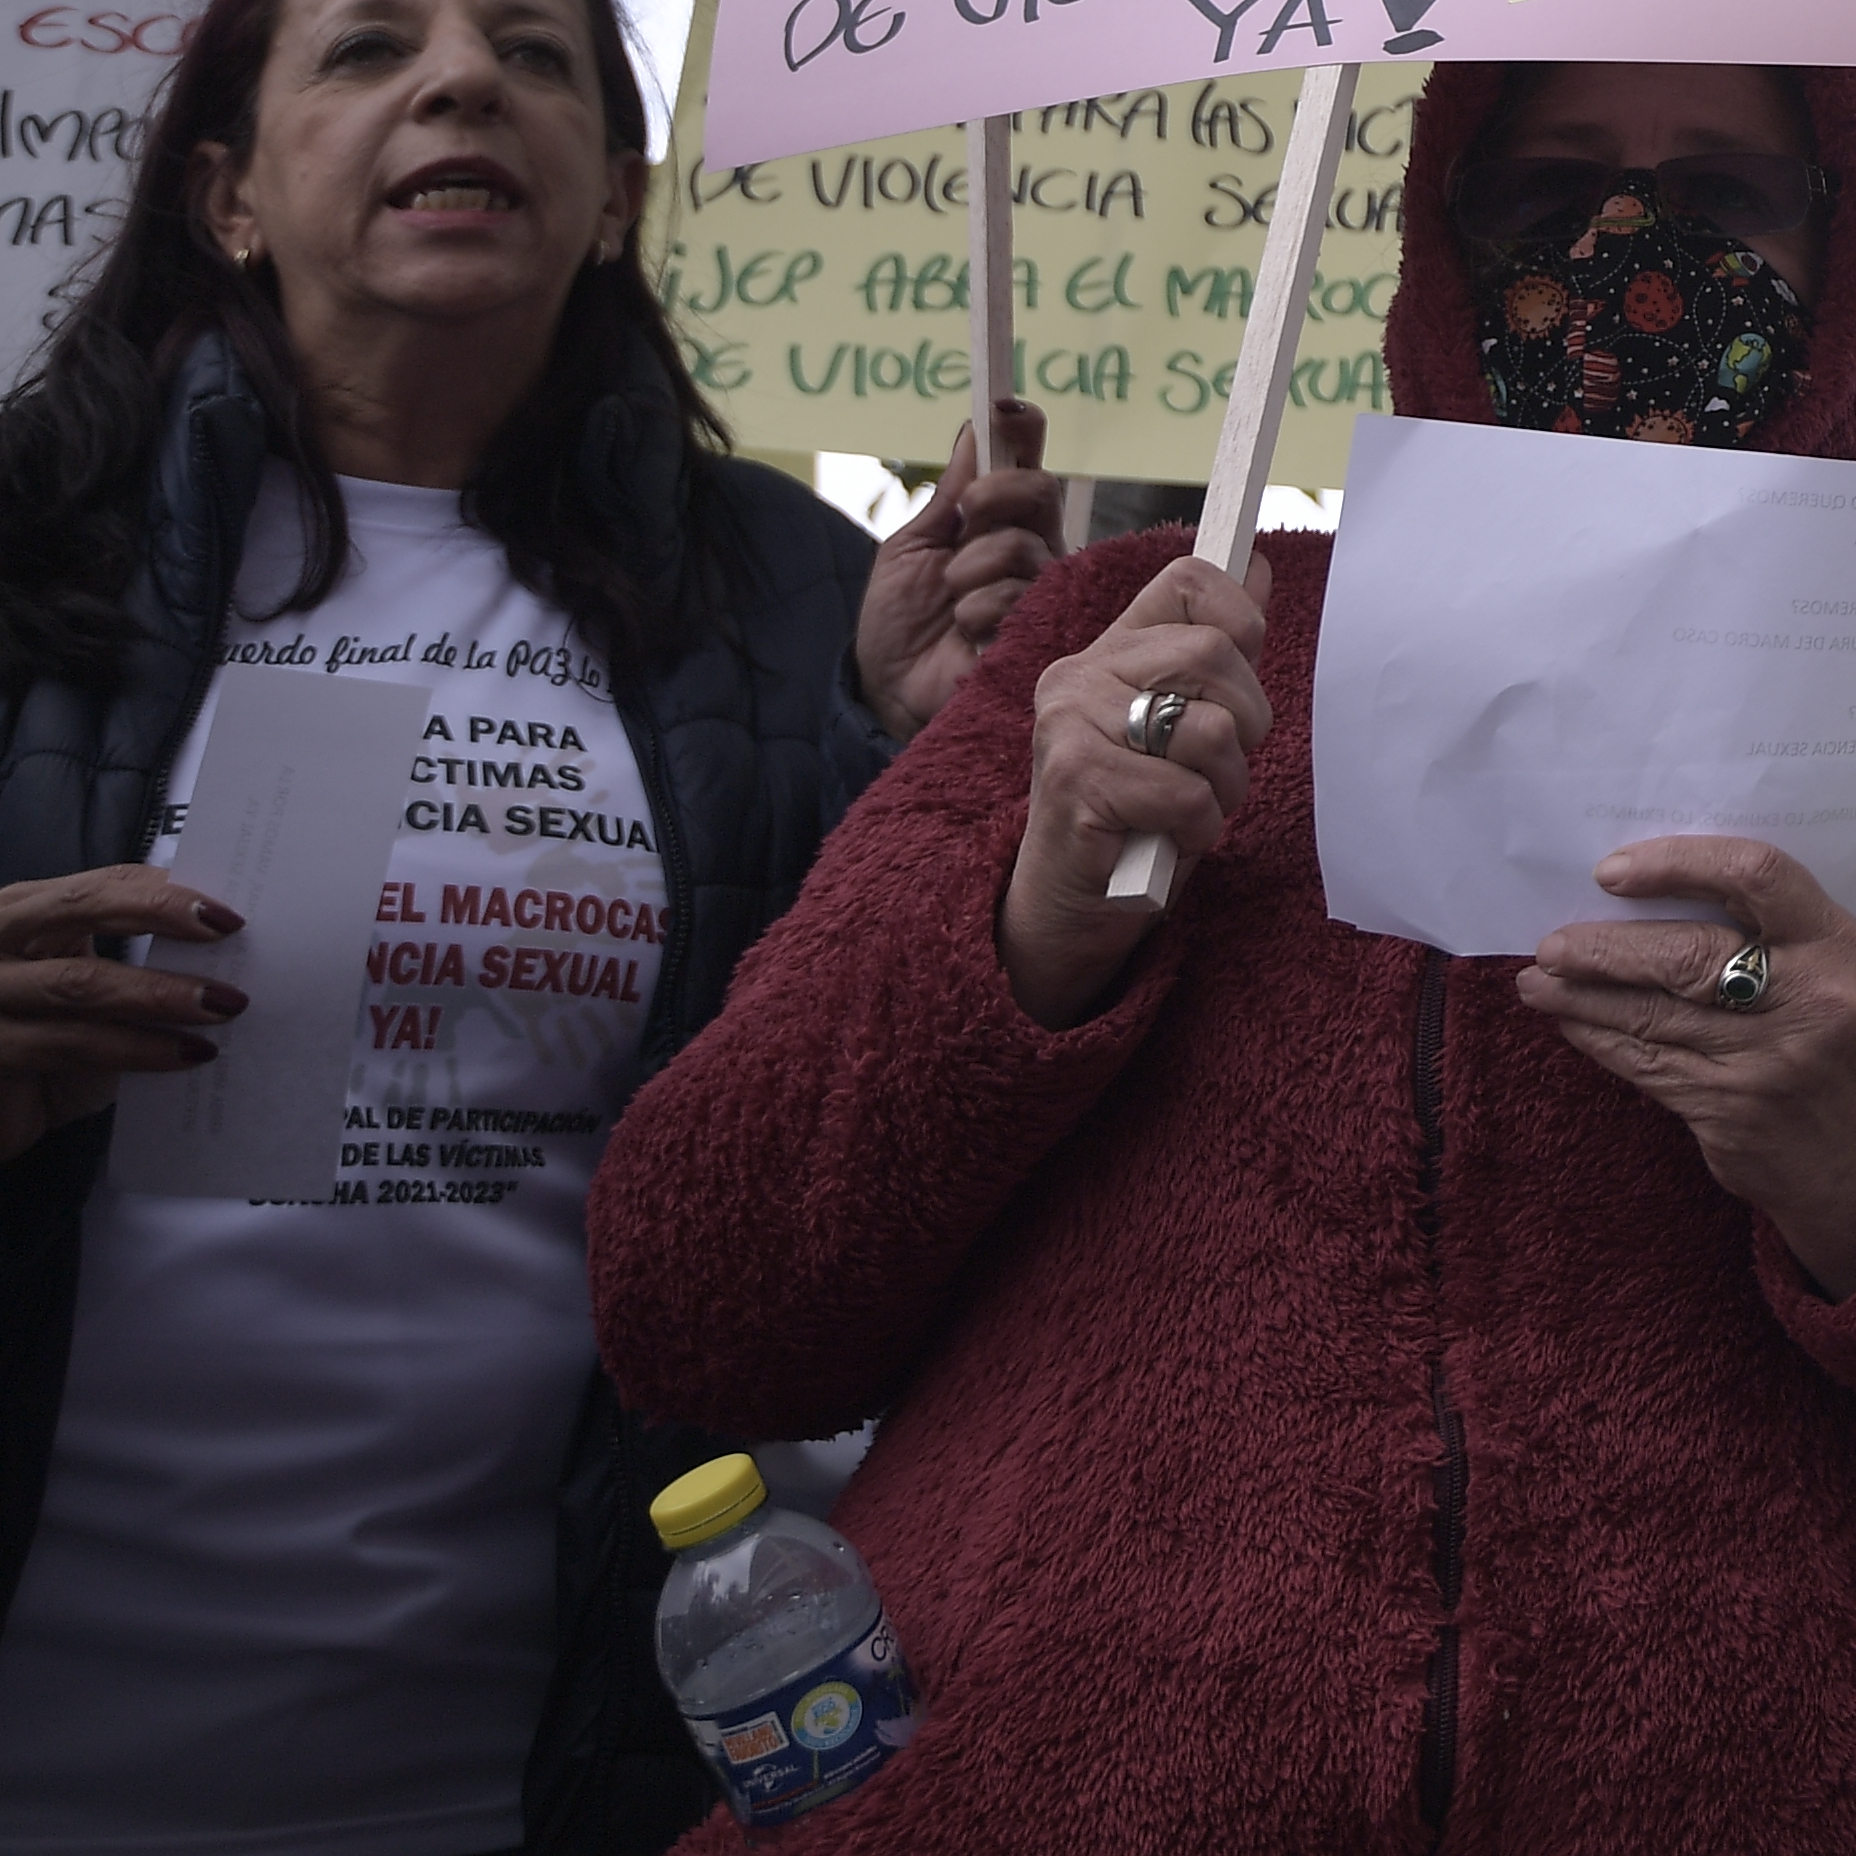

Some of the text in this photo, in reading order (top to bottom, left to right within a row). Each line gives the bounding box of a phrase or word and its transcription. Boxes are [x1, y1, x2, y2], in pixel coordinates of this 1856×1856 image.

[326, 633, 418, 674] final
[421, 632, 457, 669] de
[470, 715, 588, 752] PARA
[479, 946, 641, 1003] SEXUAL
[370, 1004, 443, 1050] YA!
[388, 1106, 426, 1132] DE
[387, 1143, 430, 1167] LAS
